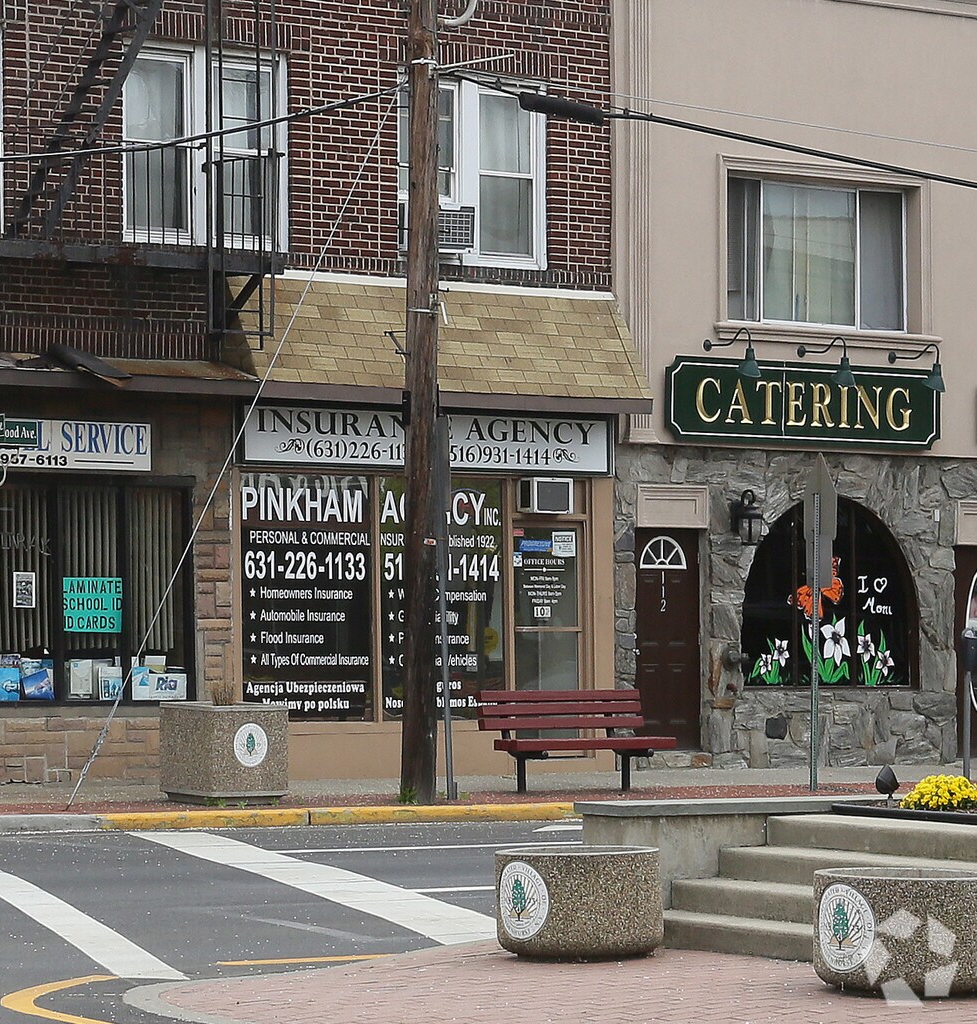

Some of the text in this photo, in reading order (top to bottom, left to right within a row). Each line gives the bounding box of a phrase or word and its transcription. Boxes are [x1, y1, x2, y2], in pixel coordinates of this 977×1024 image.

[696, 377, 913, 431] CATERING
[257, 409, 595, 446] INSURAN AGENCY
[61, 422, 148, 455] SERVICE
[0, 453, 68, 466] 957-6113
[307, 438, 552, 466] (631)226-11 516)931-1414
[242, 487, 501, 526] PINKHAM ACY INC.
[250, 530, 300, 545] PERSONAL
[301, 531, 308, 545] &
[310, 532, 371, 546] COMMERCIAL
[477, 535, 495, 548] 1922
[244, 550, 500, 582] 631-226-1133 511-1414
[524, 558, 565, 566] OFFICE HOURS
[63, 580, 122, 594] LAMINATE
[857, 575, 869, 593] I
[260, 586, 353, 600] Homeowners Insurance
[63, 597, 122, 611] SCHOOL ID
[862, 596, 893, 615] Mom
[64, 616, 116, 630] ID CARDS
[260, 609, 346, 622] Automobile Insurance
[261, 631, 324, 644] Flood Insurance
[261, 653, 370, 668] All Types Of Commercial Insurance
[155, 676, 179, 692] Ria
[246, 681, 365, 696] Agencja Ubezpieczeniowa
[304, 700, 316, 712] po
[318, 698, 350, 712] polsku
